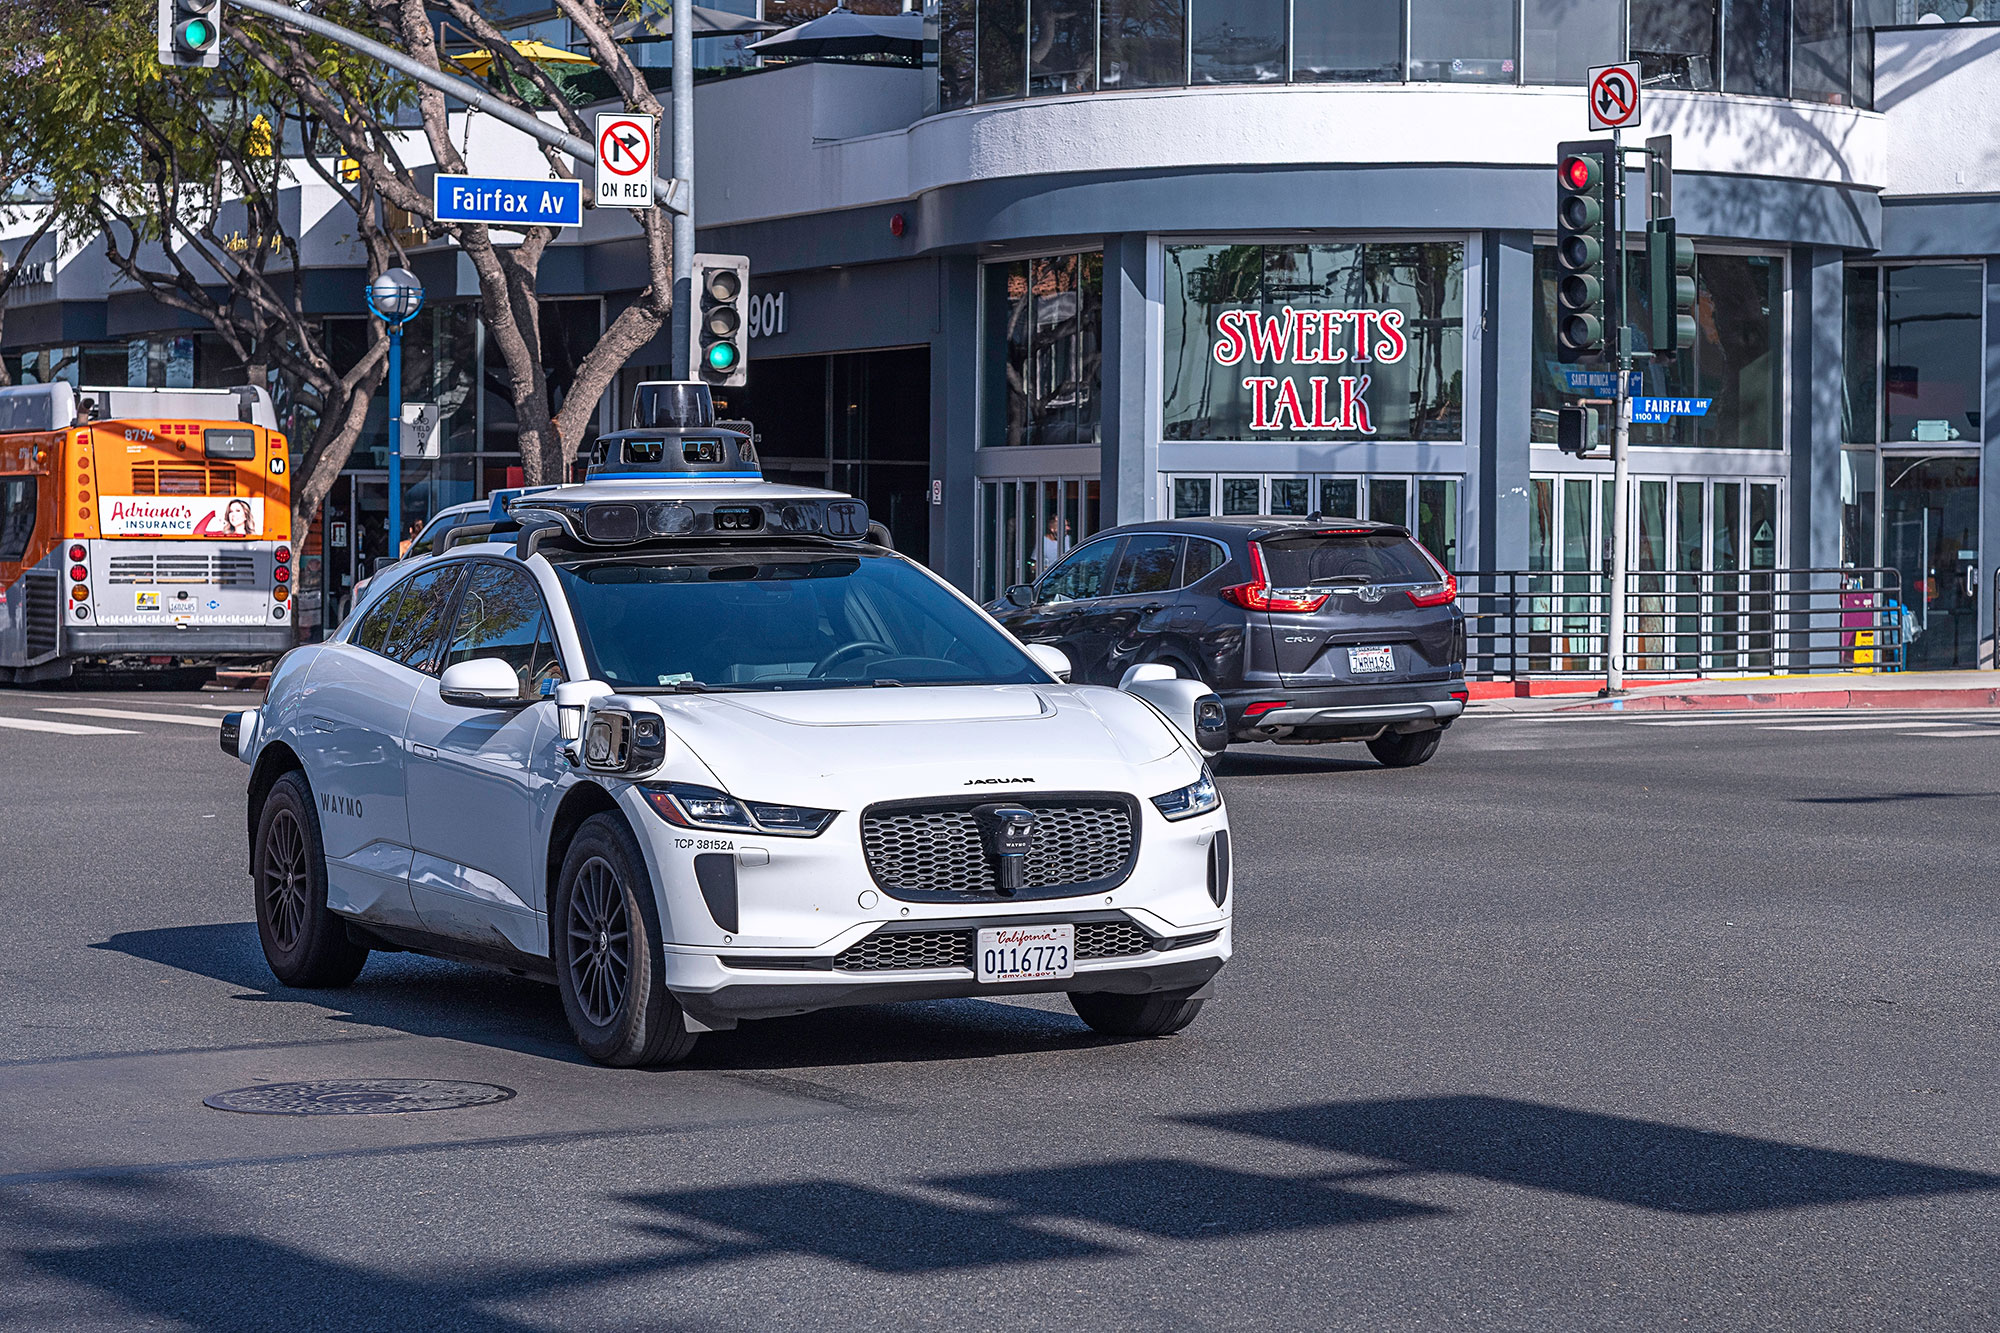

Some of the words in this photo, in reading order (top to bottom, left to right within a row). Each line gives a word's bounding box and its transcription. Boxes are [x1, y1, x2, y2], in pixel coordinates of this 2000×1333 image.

[602, 182, 618, 197] ON
[624, 183, 648, 198] RED
[452, 186, 528, 213] Fairfax
[539, 190, 564, 214] Av
[1213, 305, 1407, 366] SWEETS
[1571, 373, 1588, 386] SANTA
[1589, 374, 1609, 387] MONICA
[1242, 374, 1377, 435] TALK
[1645, 399, 1691, 413] FAIRFAX
[1696, 401, 1707, 409] AVE
[1635, 413, 1652, 421] 1100
[1655, 413, 1661, 421] N
[124, 429, 155, 441] 8794
[111, 501, 192, 521] Adriana's
[125, 520, 192, 529] INSURANCE
[1353, 655, 1391, 668] 7WRH196
[963, 777, 1036, 785] JAGUAR
[321, 792, 363, 818] WAYMO
[674, 838, 694, 849] TCP
[696, 840, 734, 850] 38152A
[998, 930, 1057, 946] California
[985, 945, 1068, 974] 01167Z3
[1002, 971, 1051, 979] dmv.ca.gov
